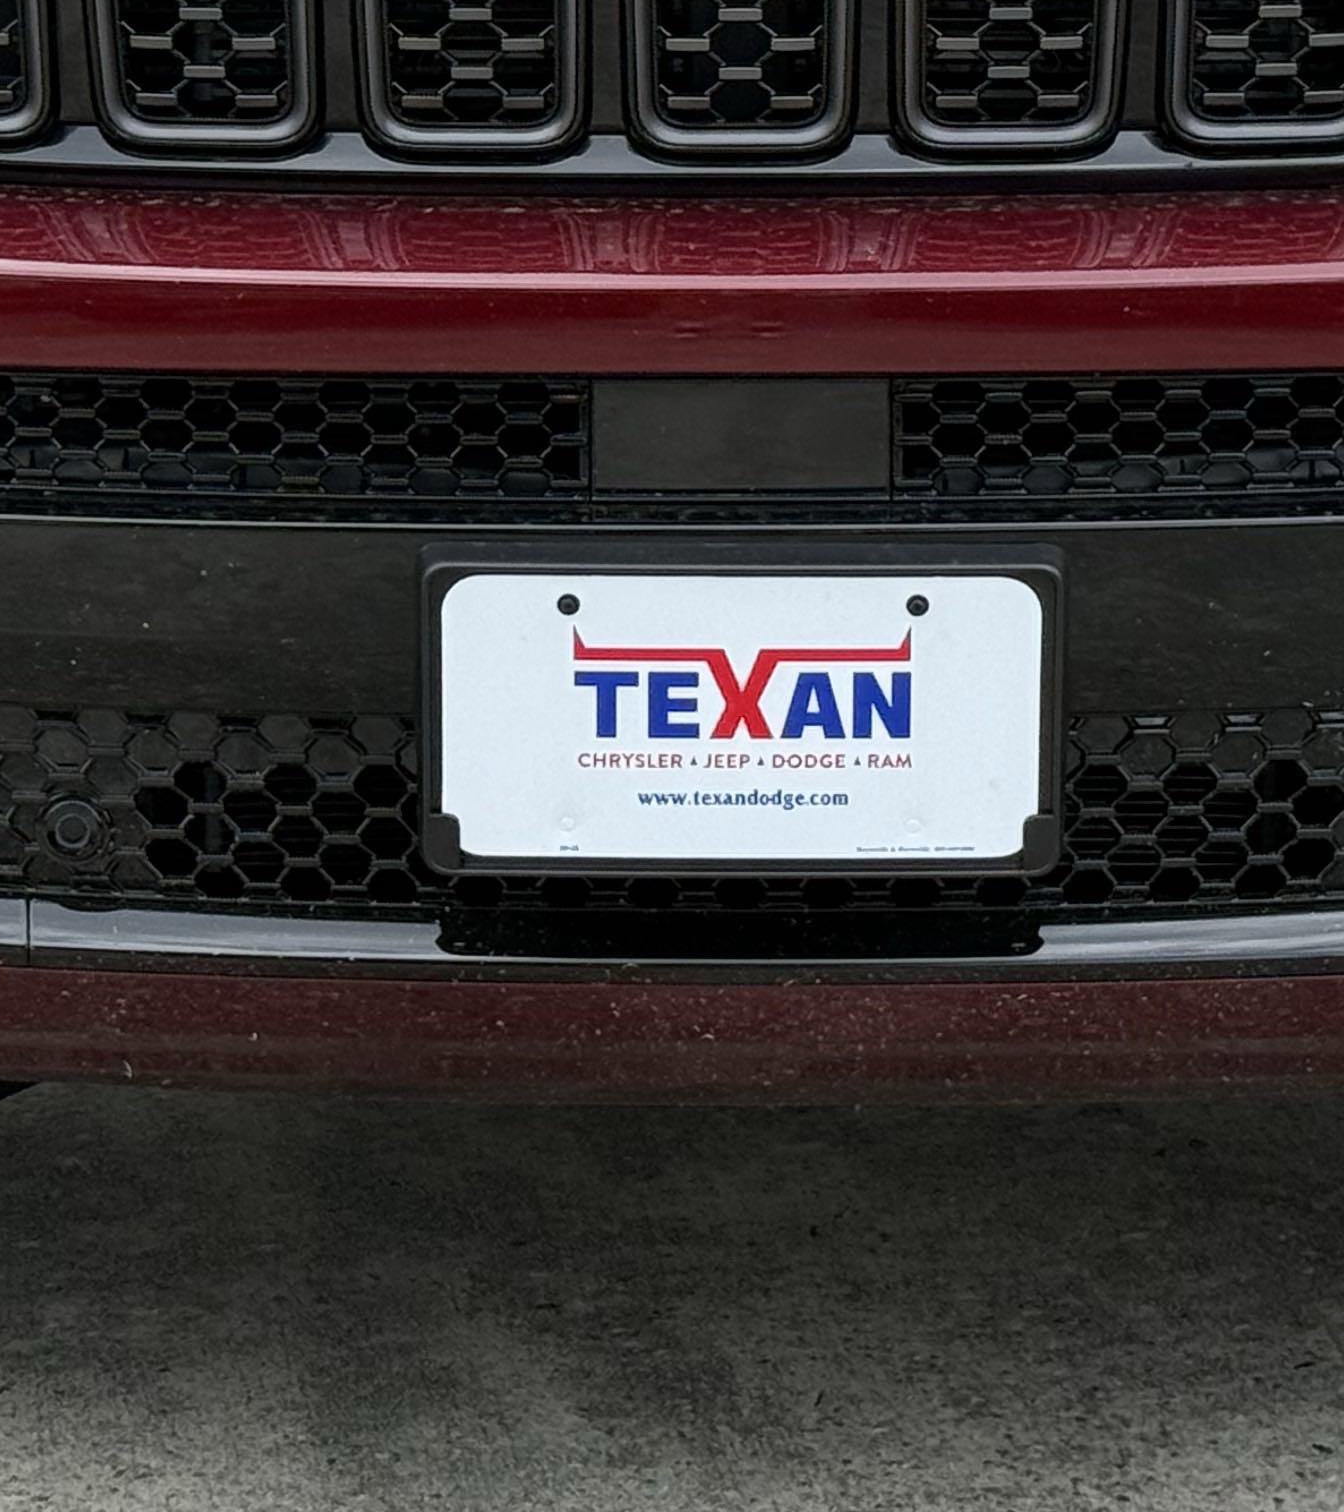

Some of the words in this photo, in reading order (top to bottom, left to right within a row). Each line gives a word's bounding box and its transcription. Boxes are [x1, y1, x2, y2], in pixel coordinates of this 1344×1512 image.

[573, 644, 912, 739] TEXAN
[577, 752, 683, 769] CHRYSLER
[702, 753, 751, 769] JEEP
[771, 753, 846, 769] DODGE
[867, 753, 913, 769] RAM
[637, 789, 849, 810] www.texandodge.com
